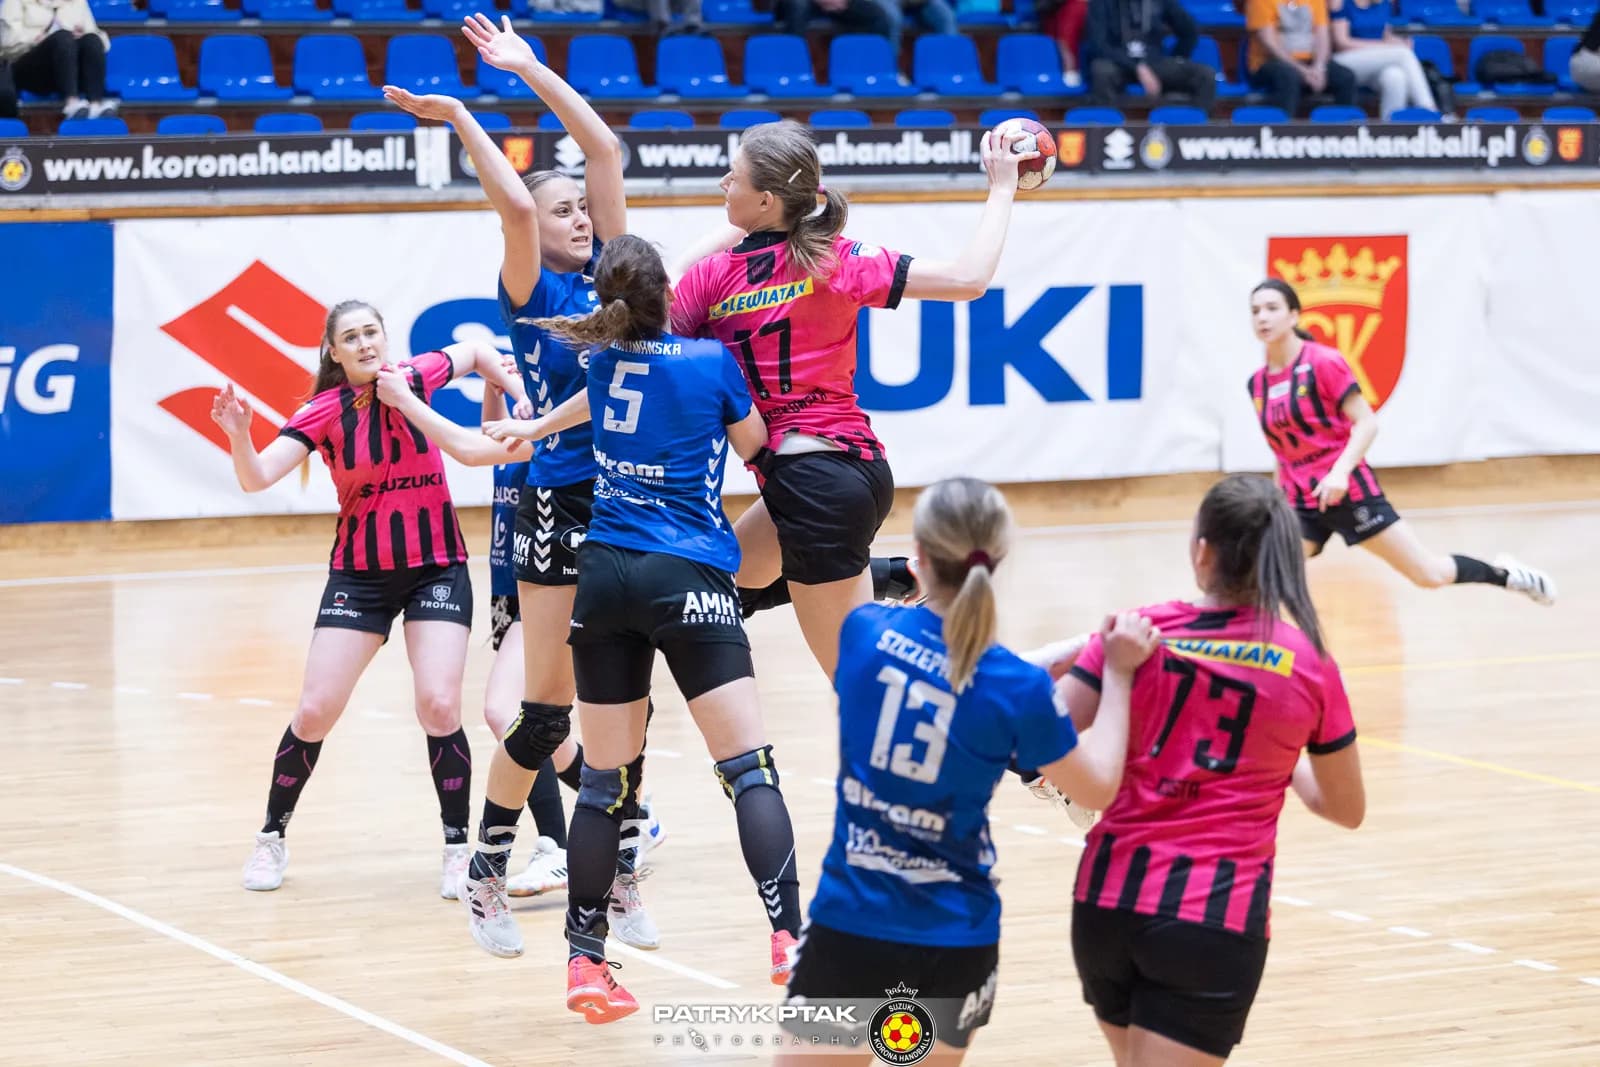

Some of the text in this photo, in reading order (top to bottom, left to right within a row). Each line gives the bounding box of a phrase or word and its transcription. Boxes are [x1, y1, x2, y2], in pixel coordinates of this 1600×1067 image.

[44, 136, 416, 182] www.koronahandball.
[638, 130, 981, 168] www.kahandball.
[1179, 126, 1515, 166] www.koronahandball.pl
[729, 280, 807, 312] LEWIATAN
[408, 282, 1144, 429] SUKI
[734, 317, 793, 401] 17
[602, 359, 650, 435] 5
[378, 472, 443, 494] SUZUKI
[421, 600, 461, 612] PROFIKA
[682, 591, 736, 617] AMH
[707, 613, 736, 626] SPORT
[869, 664, 958, 785] 13
[1150, 656, 1257, 774] 73
